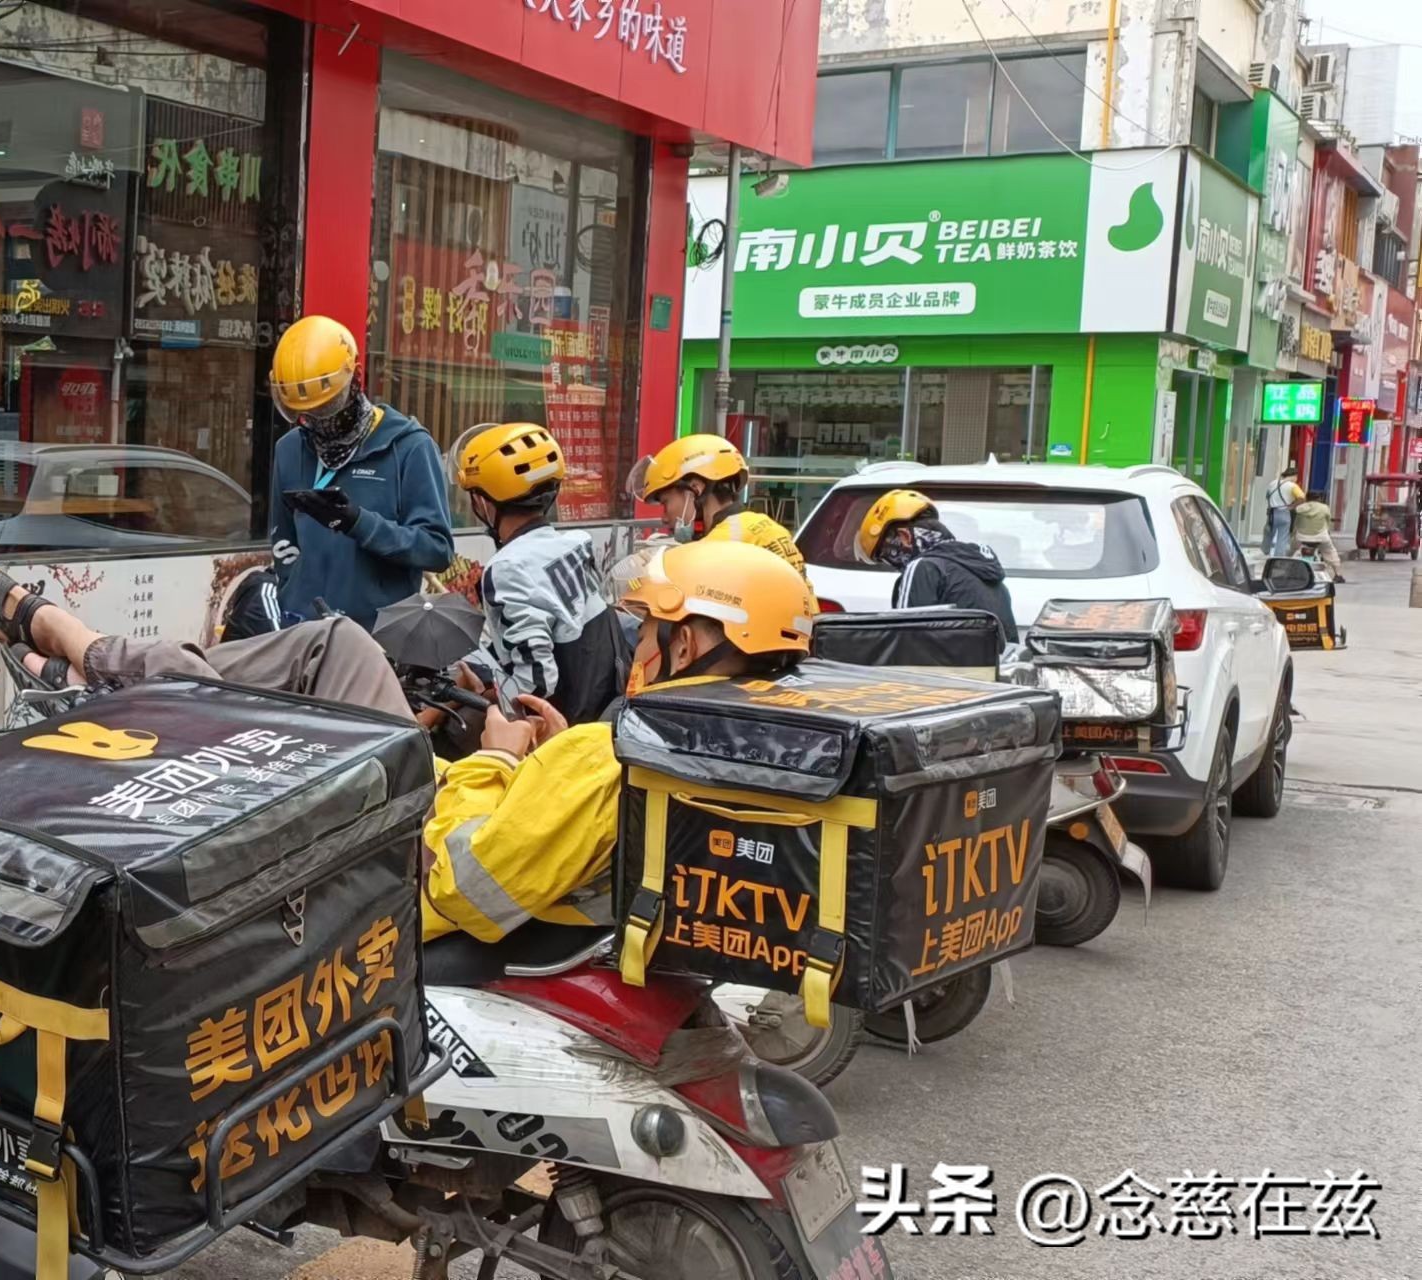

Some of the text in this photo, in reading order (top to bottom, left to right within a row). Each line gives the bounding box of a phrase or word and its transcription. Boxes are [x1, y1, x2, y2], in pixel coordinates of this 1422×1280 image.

[523, 0, 687, 73] 家乡的味道
[734, 222, 927, 272] 南小贝
[935, 239, 1078, 264] TEA 鲜奶茶饮
[938, 217, 1042, 241] BEIBEI
[813, 290, 961, 311] 蒙牛成员企业品牌
[88, 728, 305, 819] 美团外卖
[977, 788, 997, 809] 美团
[736, 837, 775, 865] 美团
[921, 819, 1031, 917] 订KTV
[672, 864, 810, 931] 订KTV
[665, 916, 807, 976] 上美团App
[911, 905, 1023, 977] 上美团App
[184, 915, 400, 1101] 美团外卖
